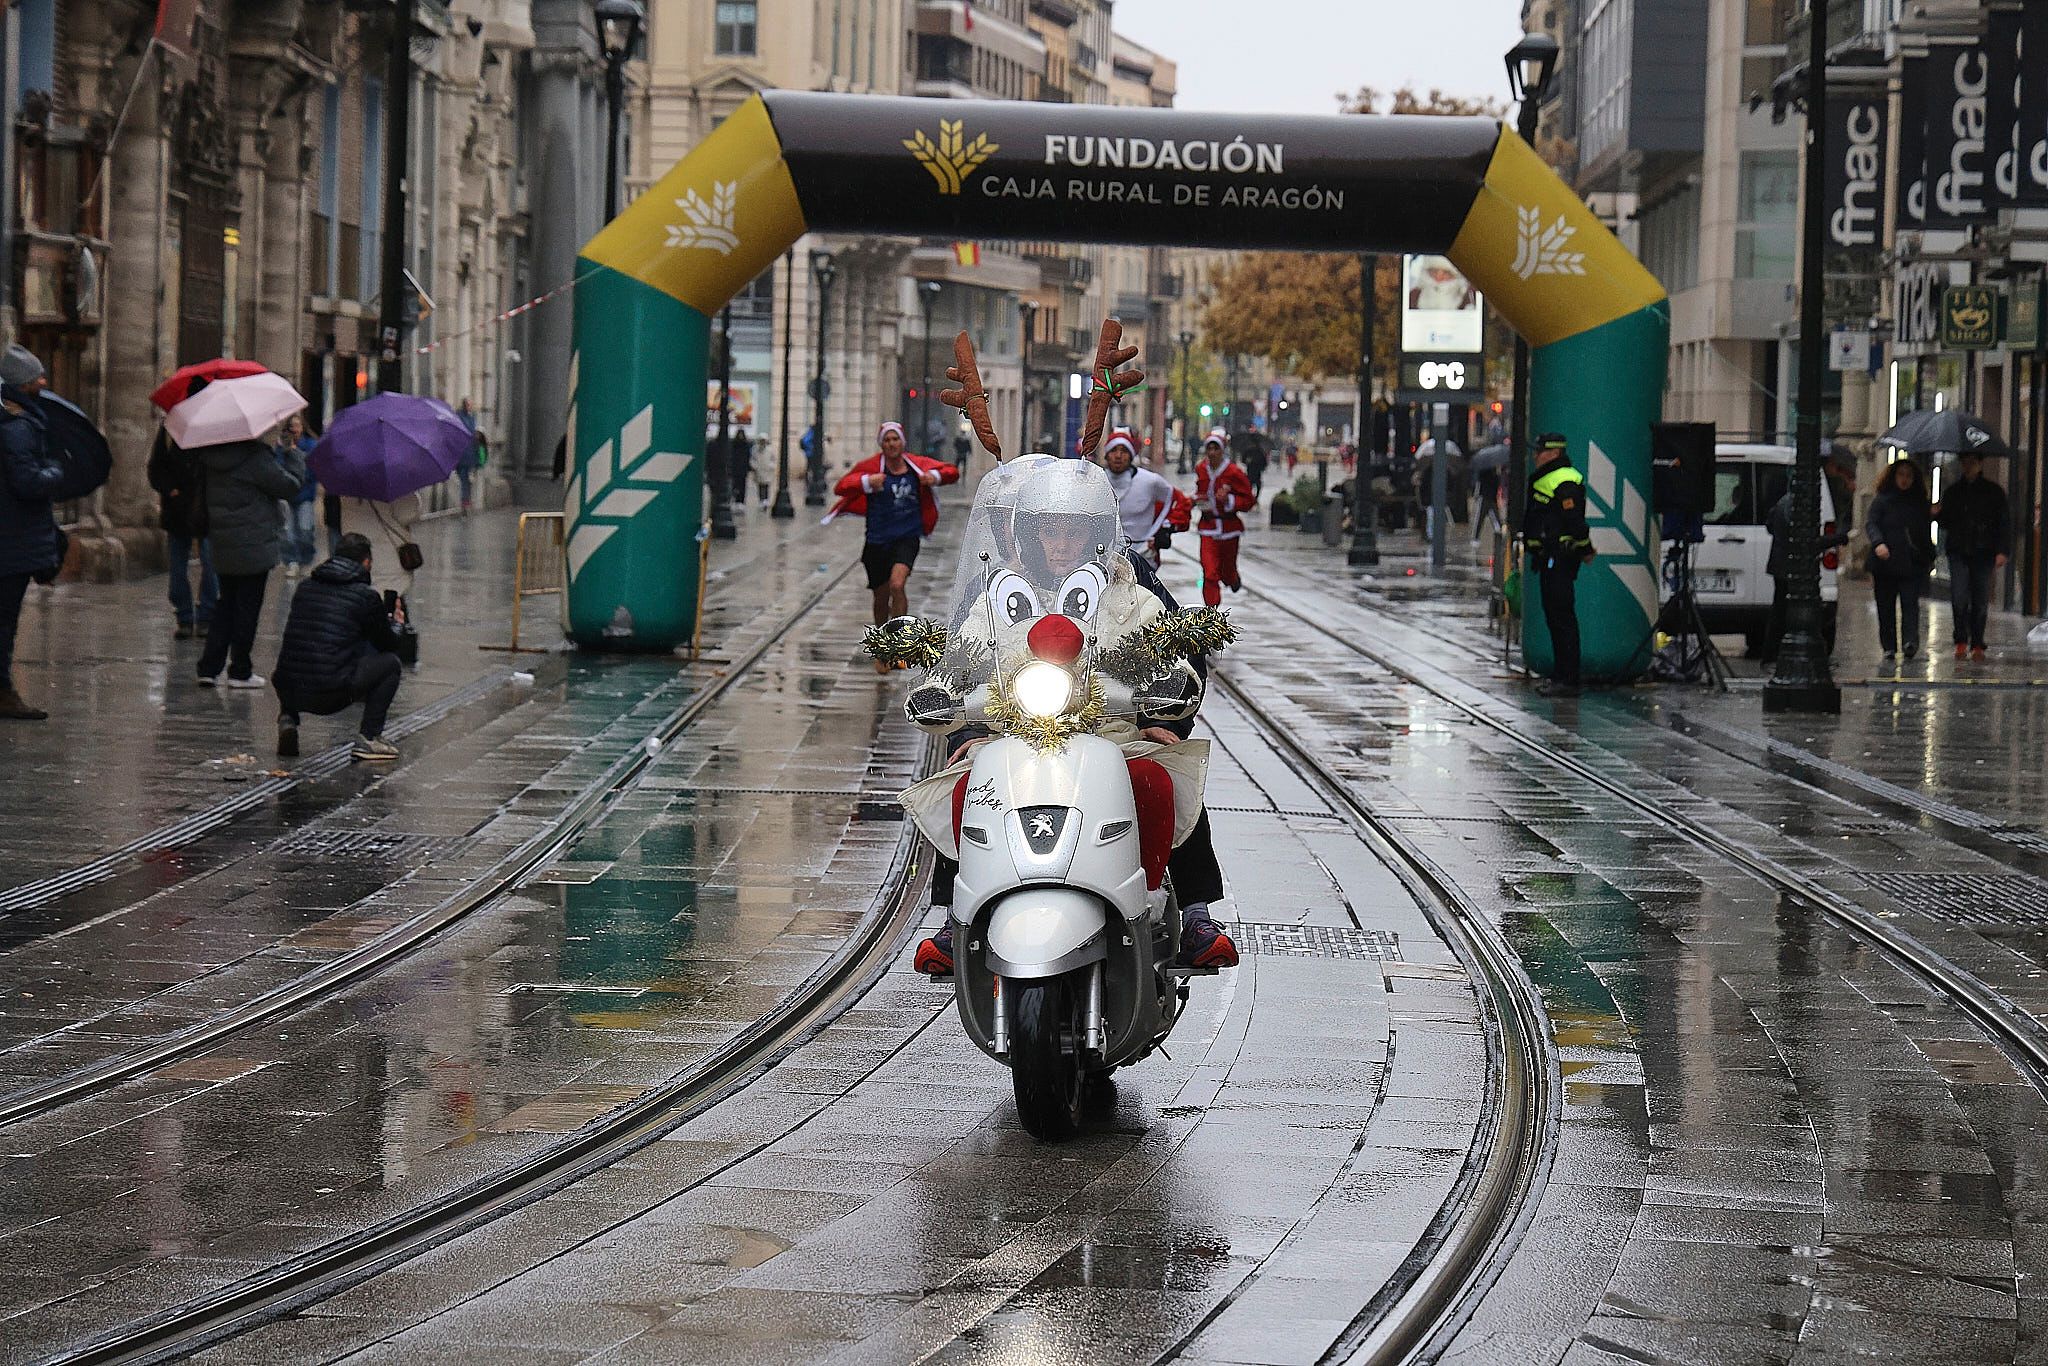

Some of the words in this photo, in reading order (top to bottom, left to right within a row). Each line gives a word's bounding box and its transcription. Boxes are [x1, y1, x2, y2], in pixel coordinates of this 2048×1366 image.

[1044, 134, 1284, 174] FUNDACIÓN
[1831, 105, 1880, 246] fnac
[1936, 52, 1988, 216] fnac
[981, 175, 1056, 200] CAJA
[1067, 179, 1162, 204] RURAL
[1174, 184, 1211, 206] DE
[1221, 184, 1345, 210] ARAGÓN
